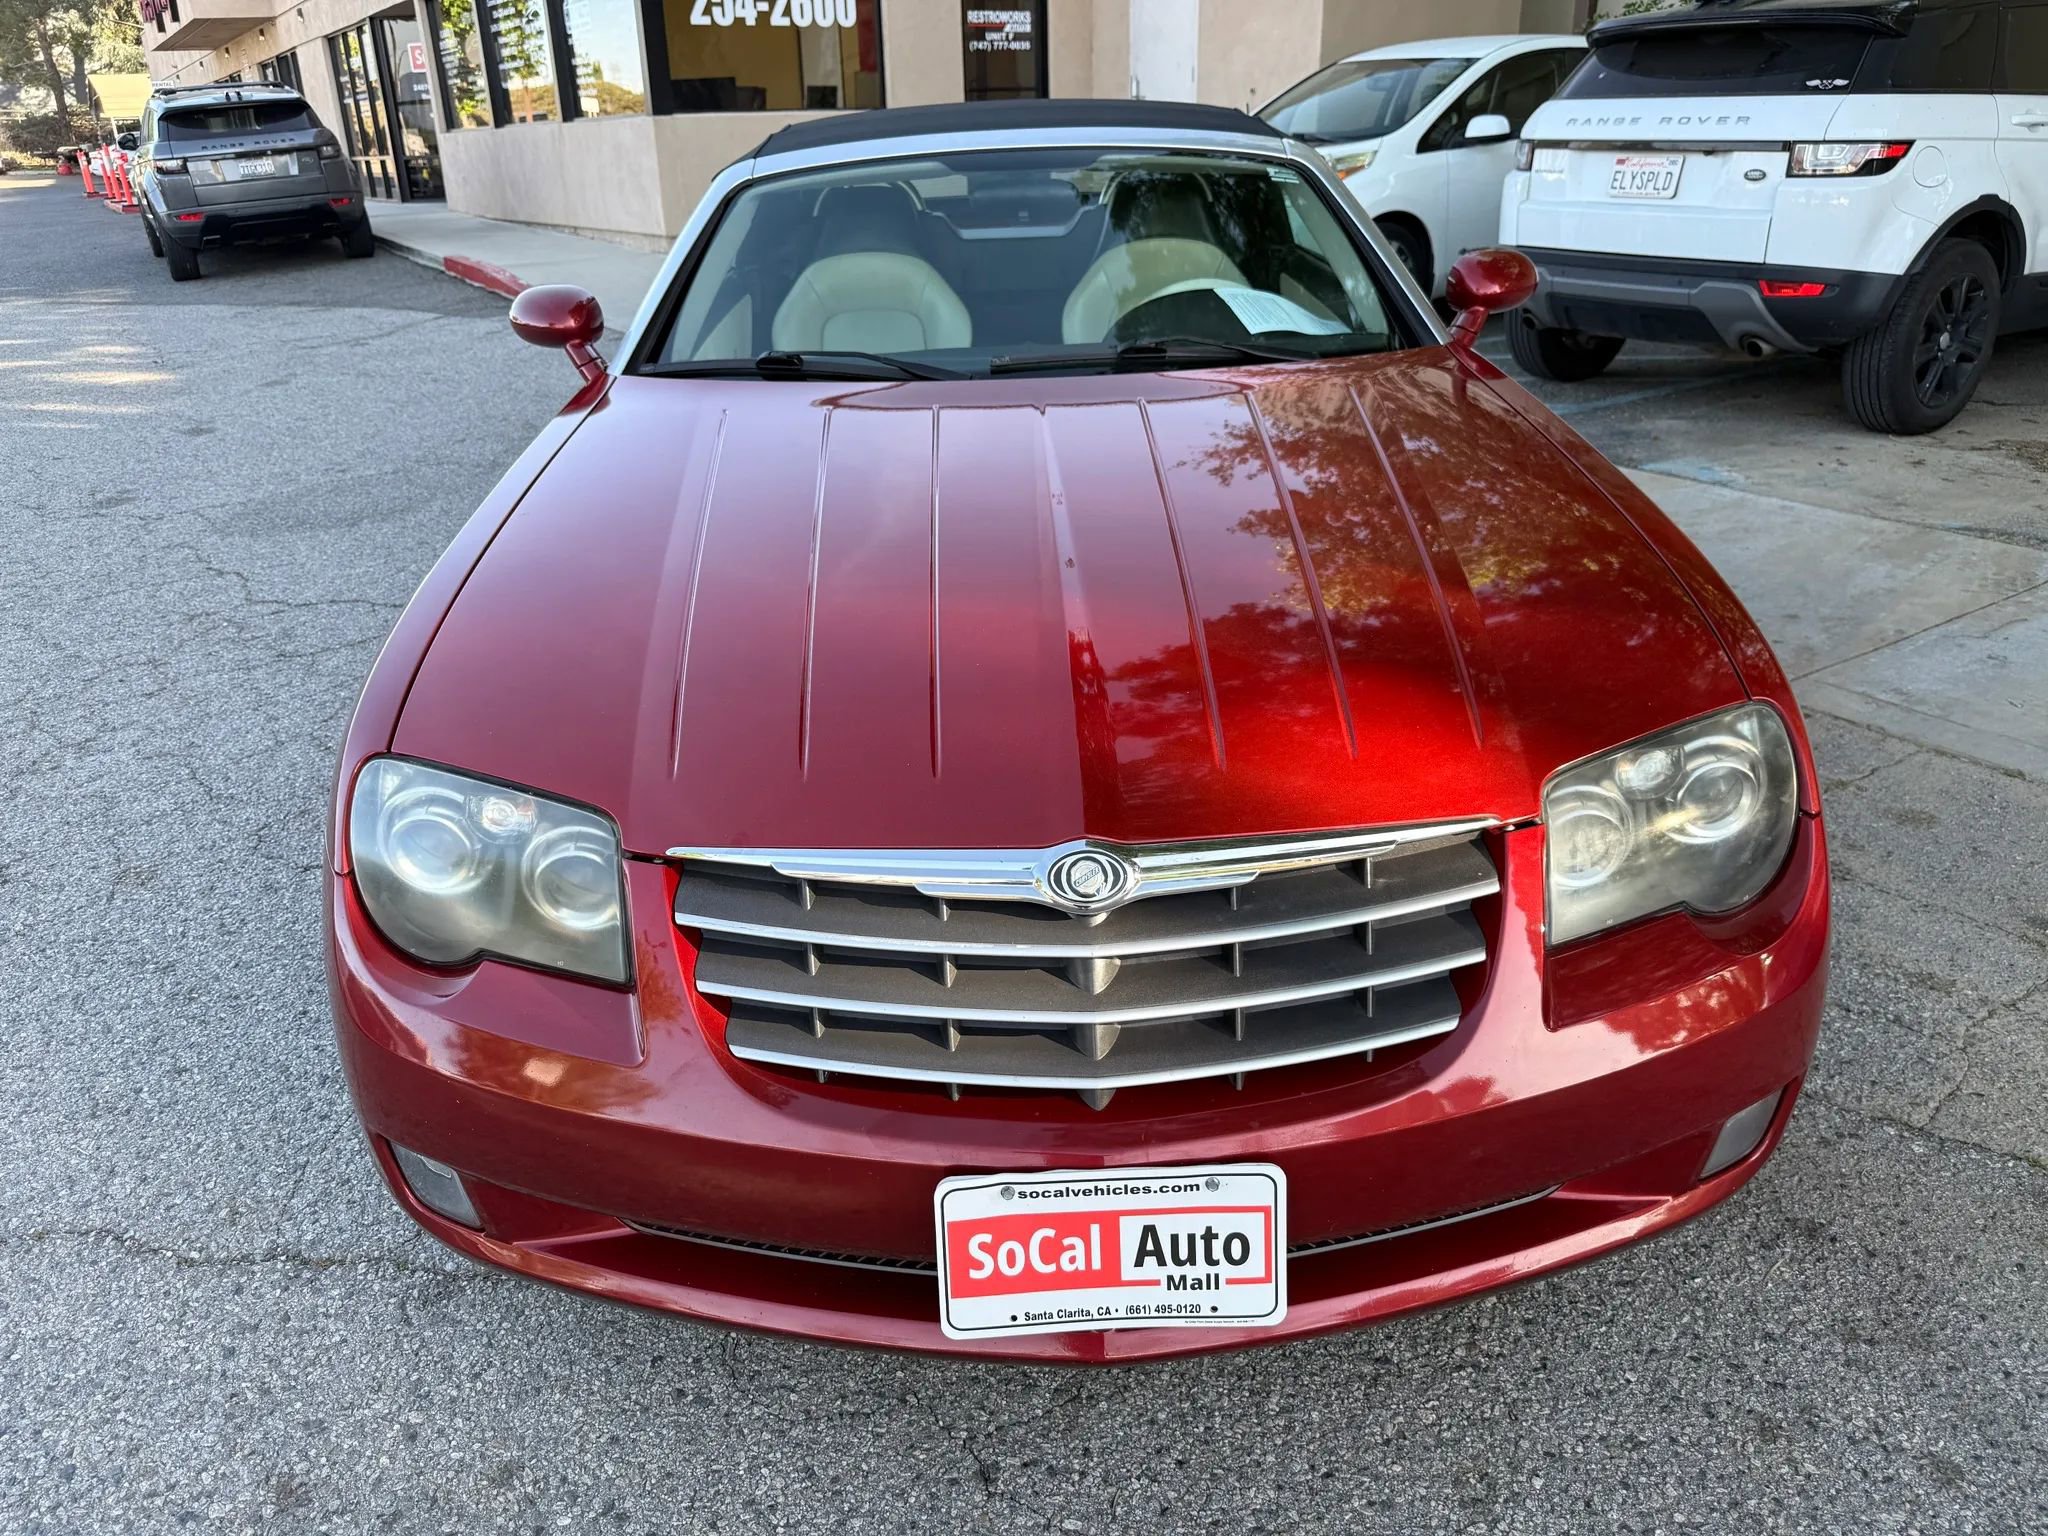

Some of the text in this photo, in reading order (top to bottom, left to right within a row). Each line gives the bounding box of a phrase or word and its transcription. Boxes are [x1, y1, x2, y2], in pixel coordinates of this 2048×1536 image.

[967, 10, 1031, 24] RESTROWORKS
[1566, 116, 1751, 126] RANGE ROVER
[201, 138, 296, 151] RANGE ROVER
[1610, 170, 1673, 191] ELYSPLD
[1017, 1183, 1200, 1199] socalvehicles.com
[968, 1223, 1251, 1280] SoCal Auto
[1166, 1273, 1220, 1291] Mall
[1024, 1303, 1201, 1322] Santa Clarita, CA (661) 495-0120
